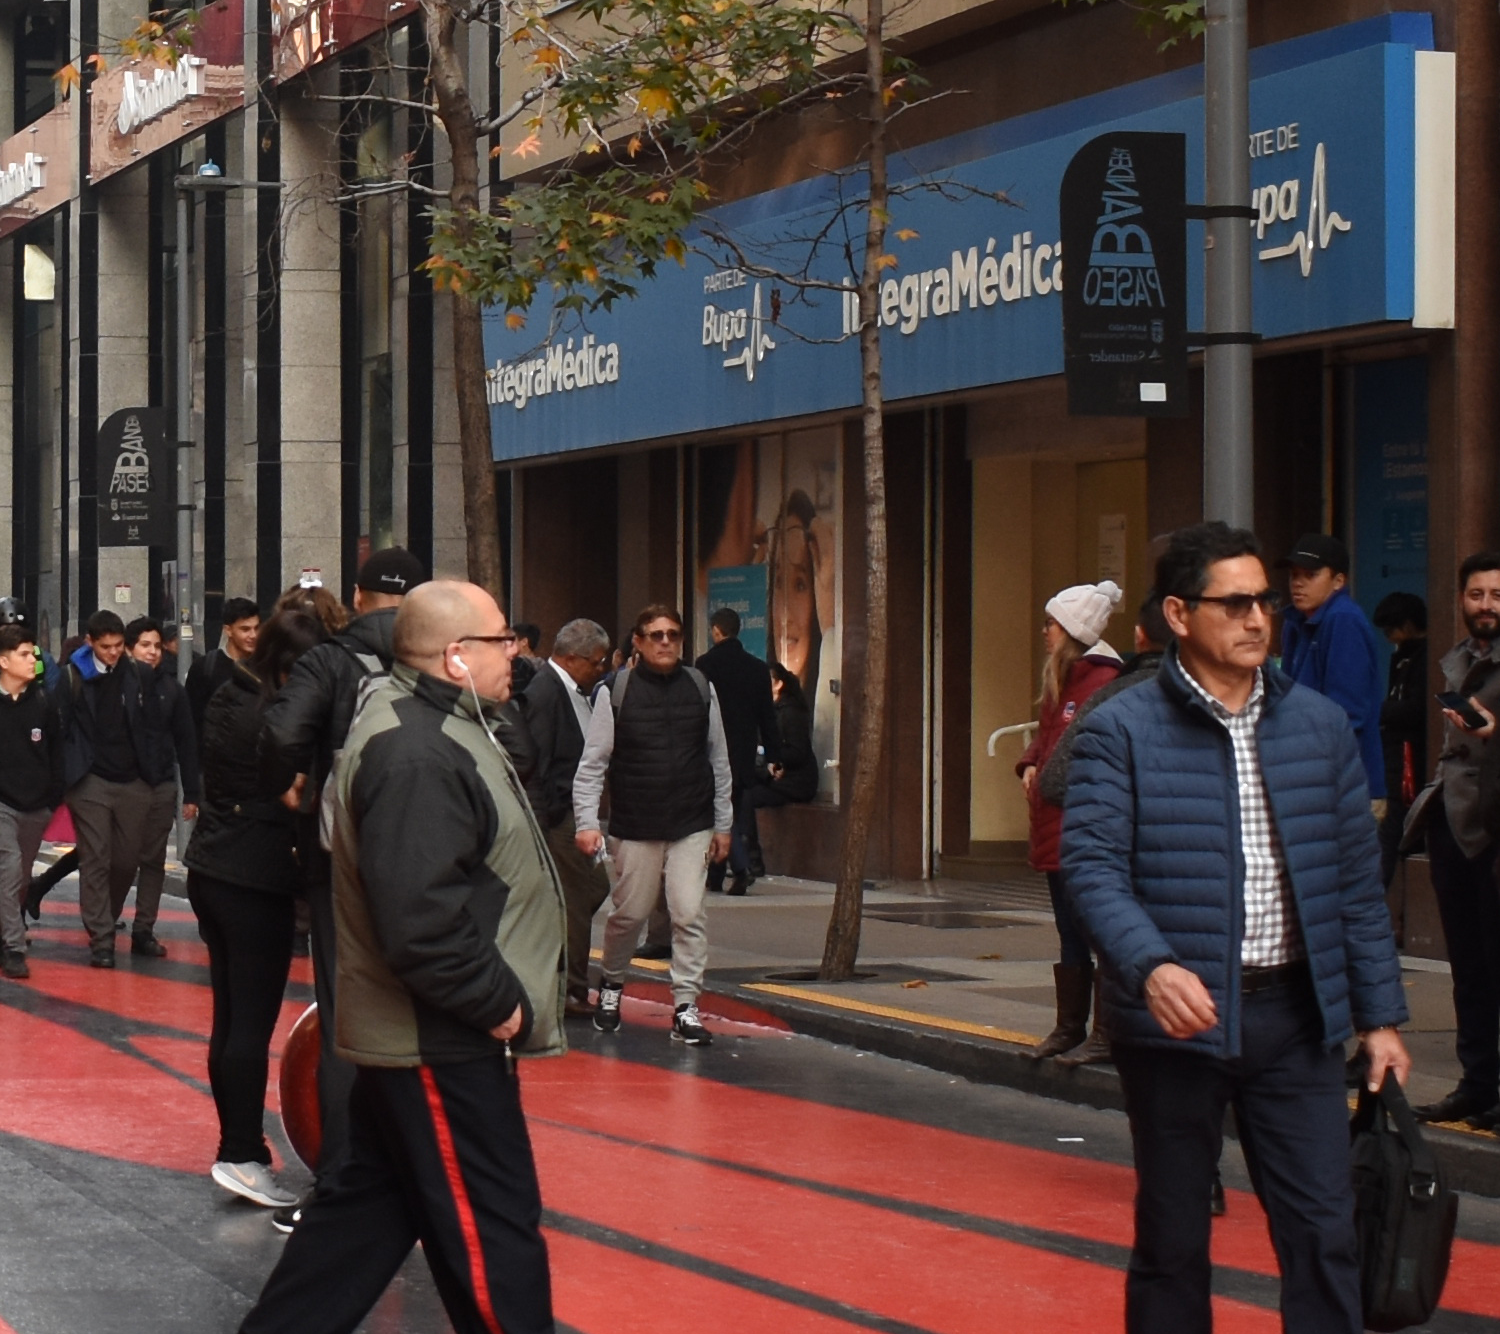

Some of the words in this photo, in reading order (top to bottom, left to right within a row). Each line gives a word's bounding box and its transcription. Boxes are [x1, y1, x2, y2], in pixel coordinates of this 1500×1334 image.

[1248, 129, 1274, 158] RTE
[1277, 122, 1300, 152] DE
[1250, 179, 1299, 240] pa
[703, 271, 732, 295] PARTE
[733, 267, 747, 288] DE
[843, 230, 1063, 335] IegraMédica
[702, 304, 747, 352] Bupa
